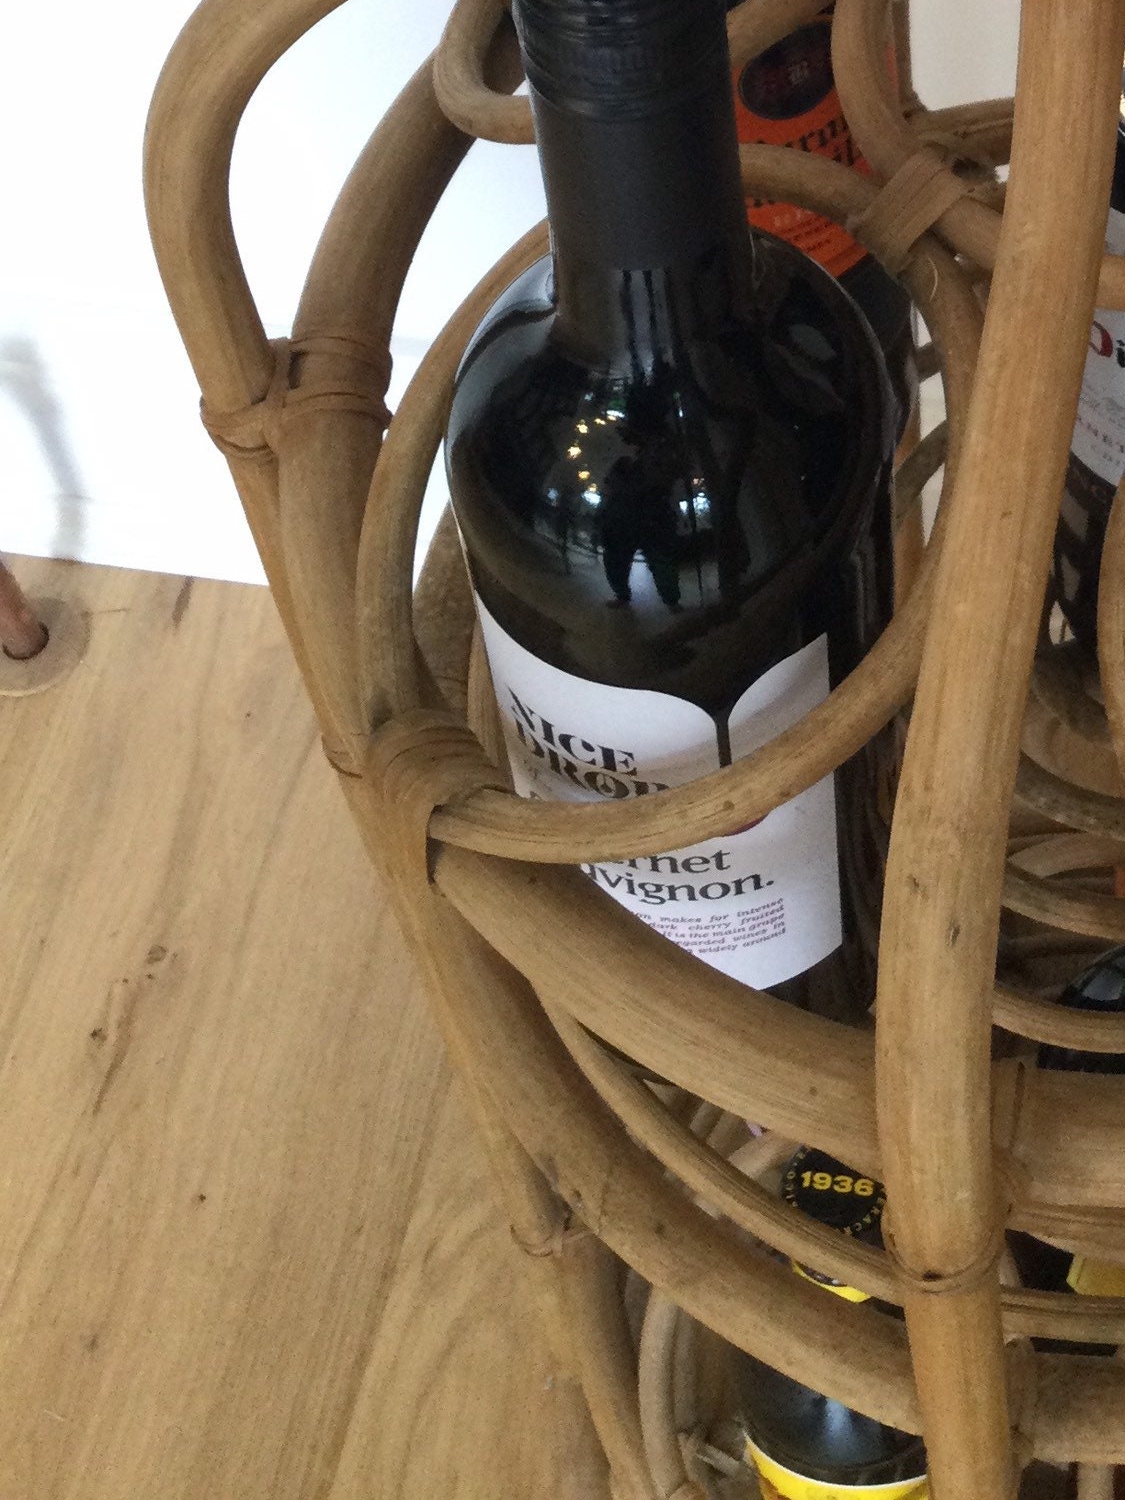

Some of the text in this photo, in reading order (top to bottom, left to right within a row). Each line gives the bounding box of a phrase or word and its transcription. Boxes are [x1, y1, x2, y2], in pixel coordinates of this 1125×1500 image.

[507, 686, 638, 777] NICE
[612, 850, 731, 874] rnet
[800, 1170, 875, 1198] 1936
